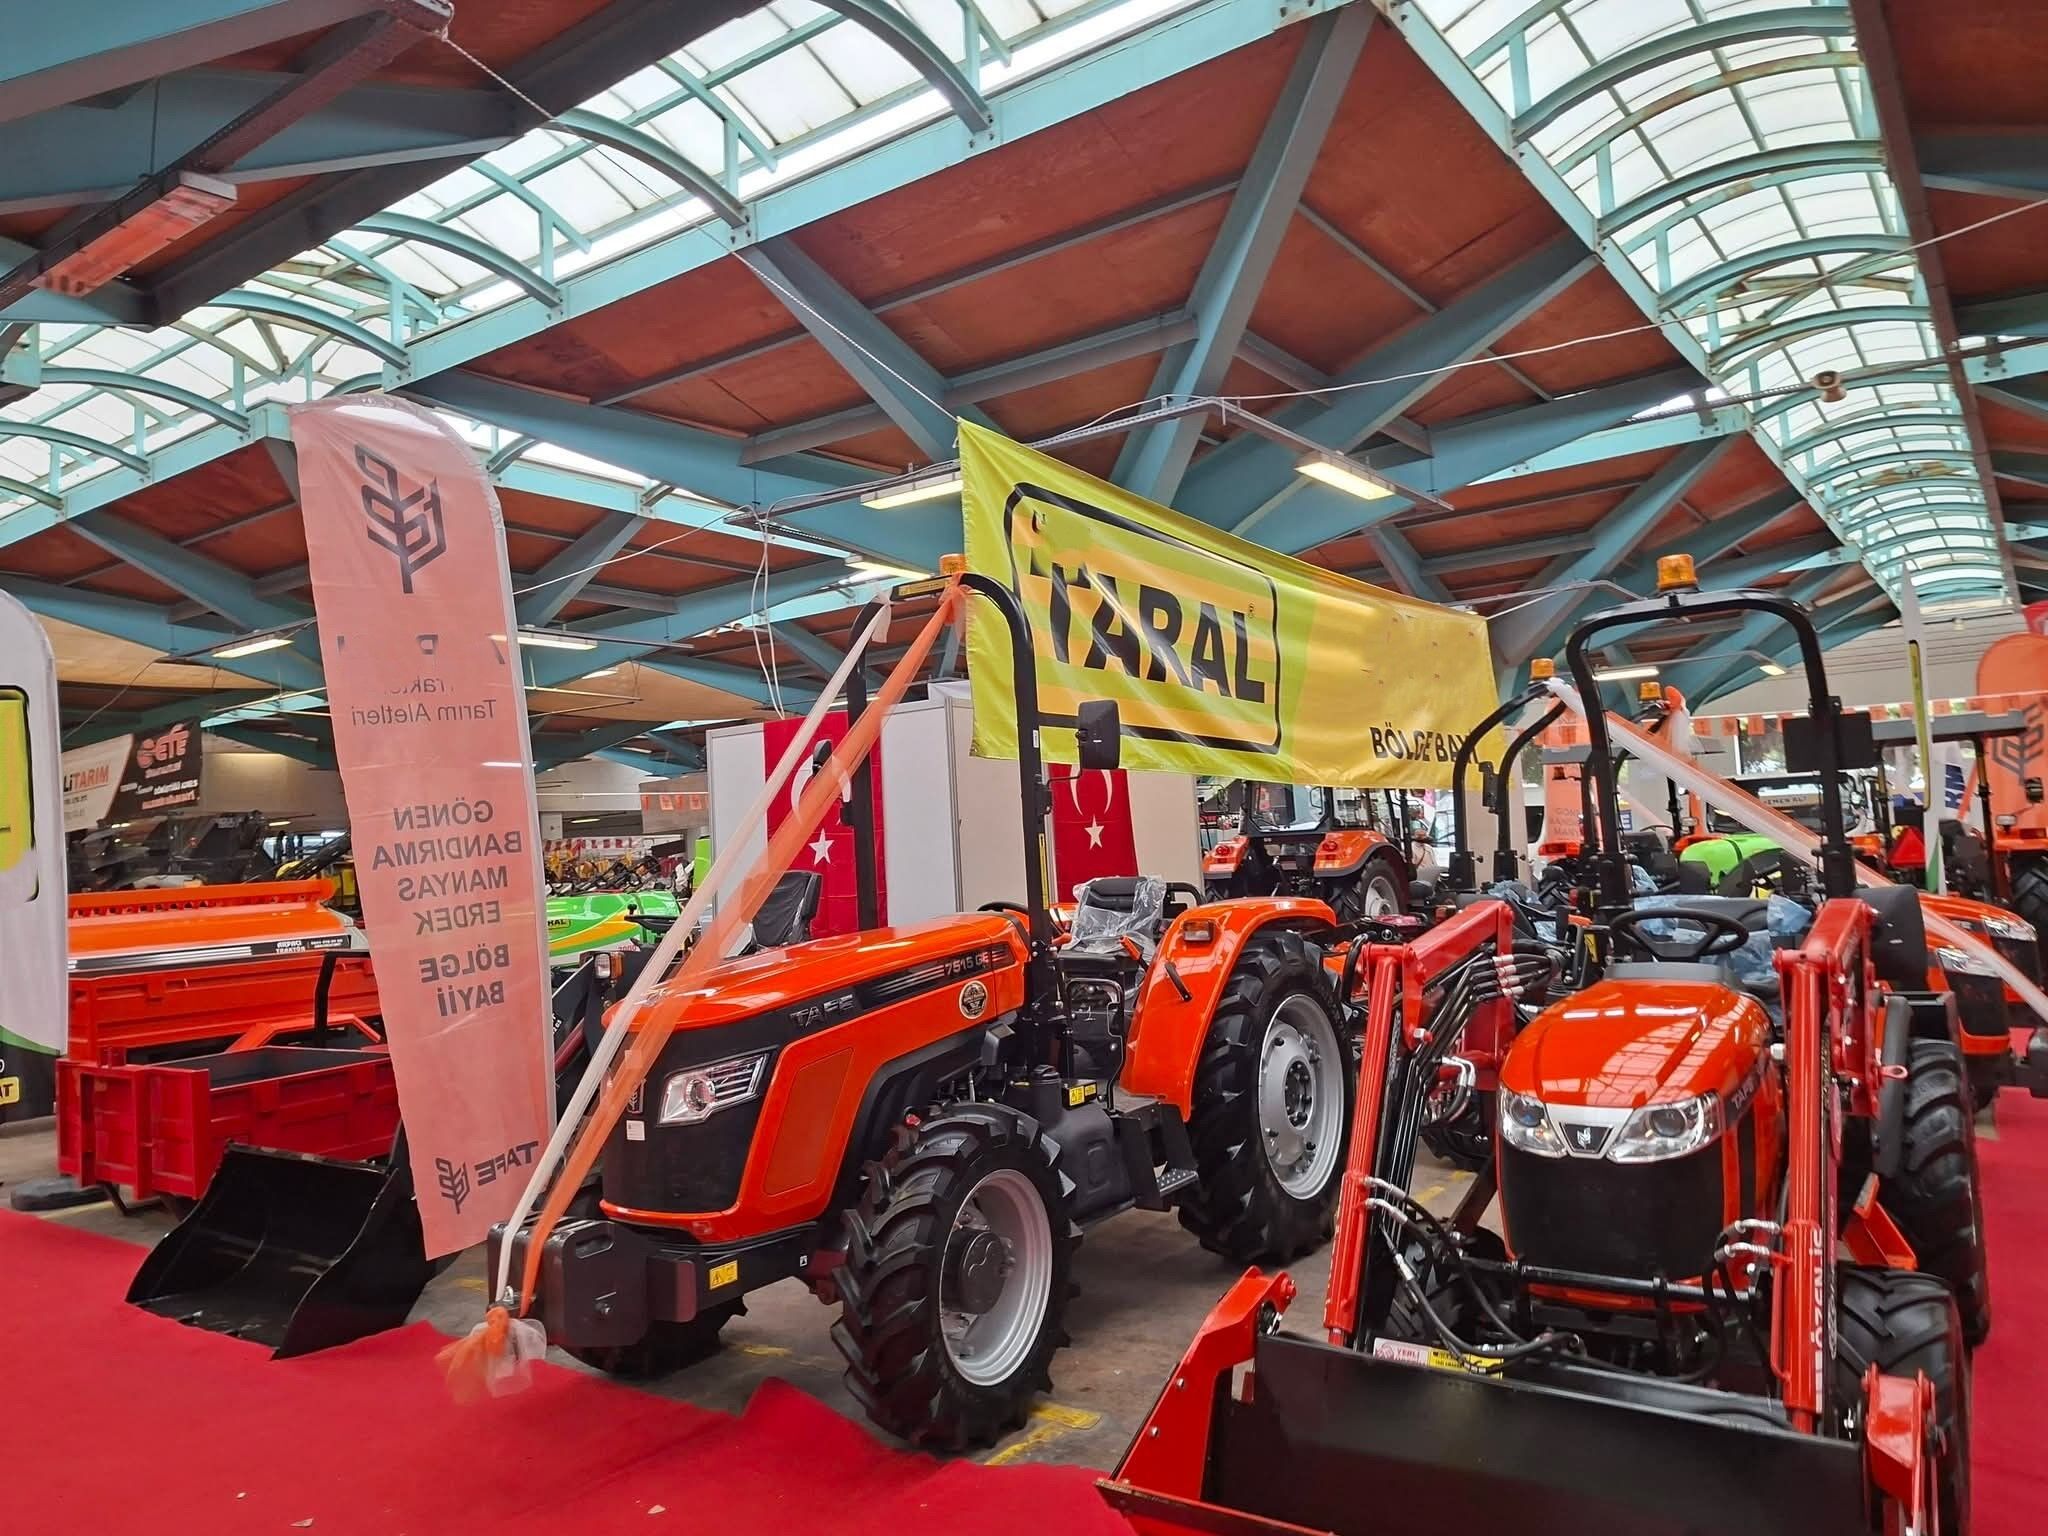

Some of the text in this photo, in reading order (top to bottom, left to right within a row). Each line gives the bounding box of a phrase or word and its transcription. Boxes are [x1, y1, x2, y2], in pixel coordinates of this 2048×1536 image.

[1030, 552, 1265, 704] TARAL
[1369, 721, 1434, 762] BÖLGE
[789, 994, 854, 1027] TAFE
